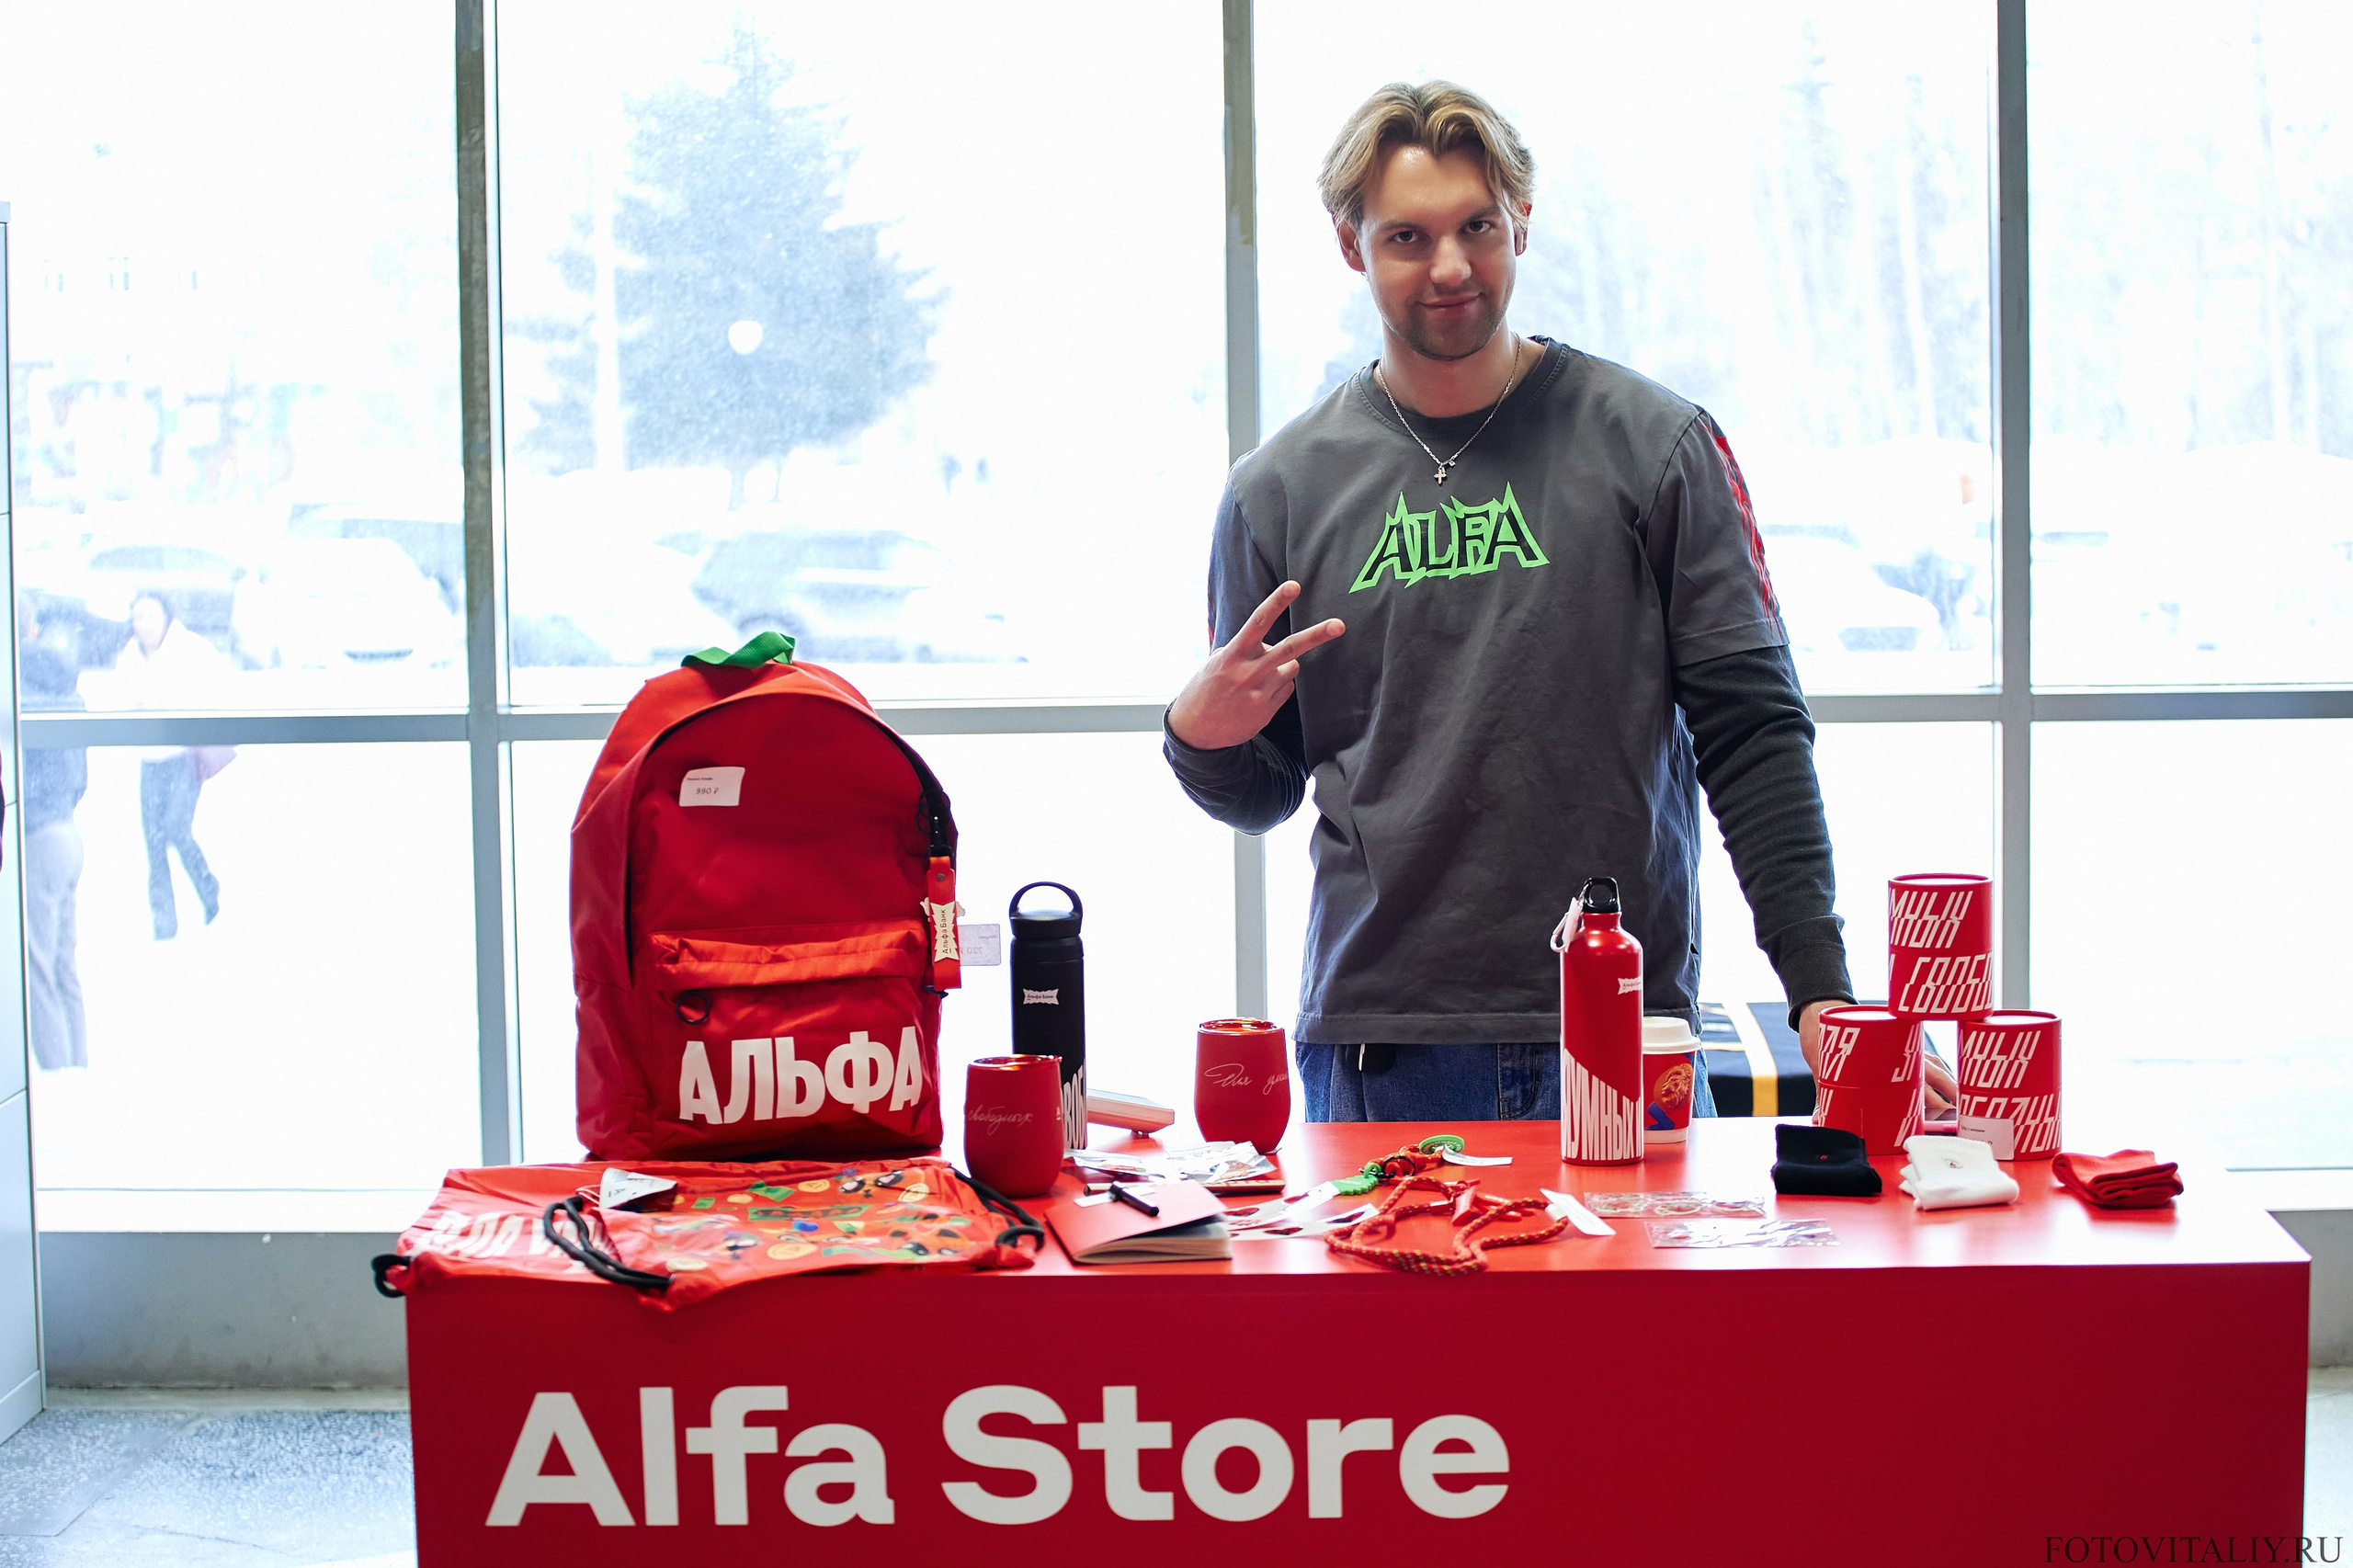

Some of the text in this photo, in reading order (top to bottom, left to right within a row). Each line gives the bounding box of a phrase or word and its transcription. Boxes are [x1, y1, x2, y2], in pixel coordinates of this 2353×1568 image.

[1348, 481, 1550, 594] ALFA
[696, 787, 711, 795] 990
[942, 929, 952, 954] Альфа
[1890, 889, 1973, 949] МНЫХ
[679, 1027, 922, 1125] АЛЬФА
[1960, 1028, 2041, 1088] МНЫХ
[485, 1384, 1510, 1527] Alfa Store
